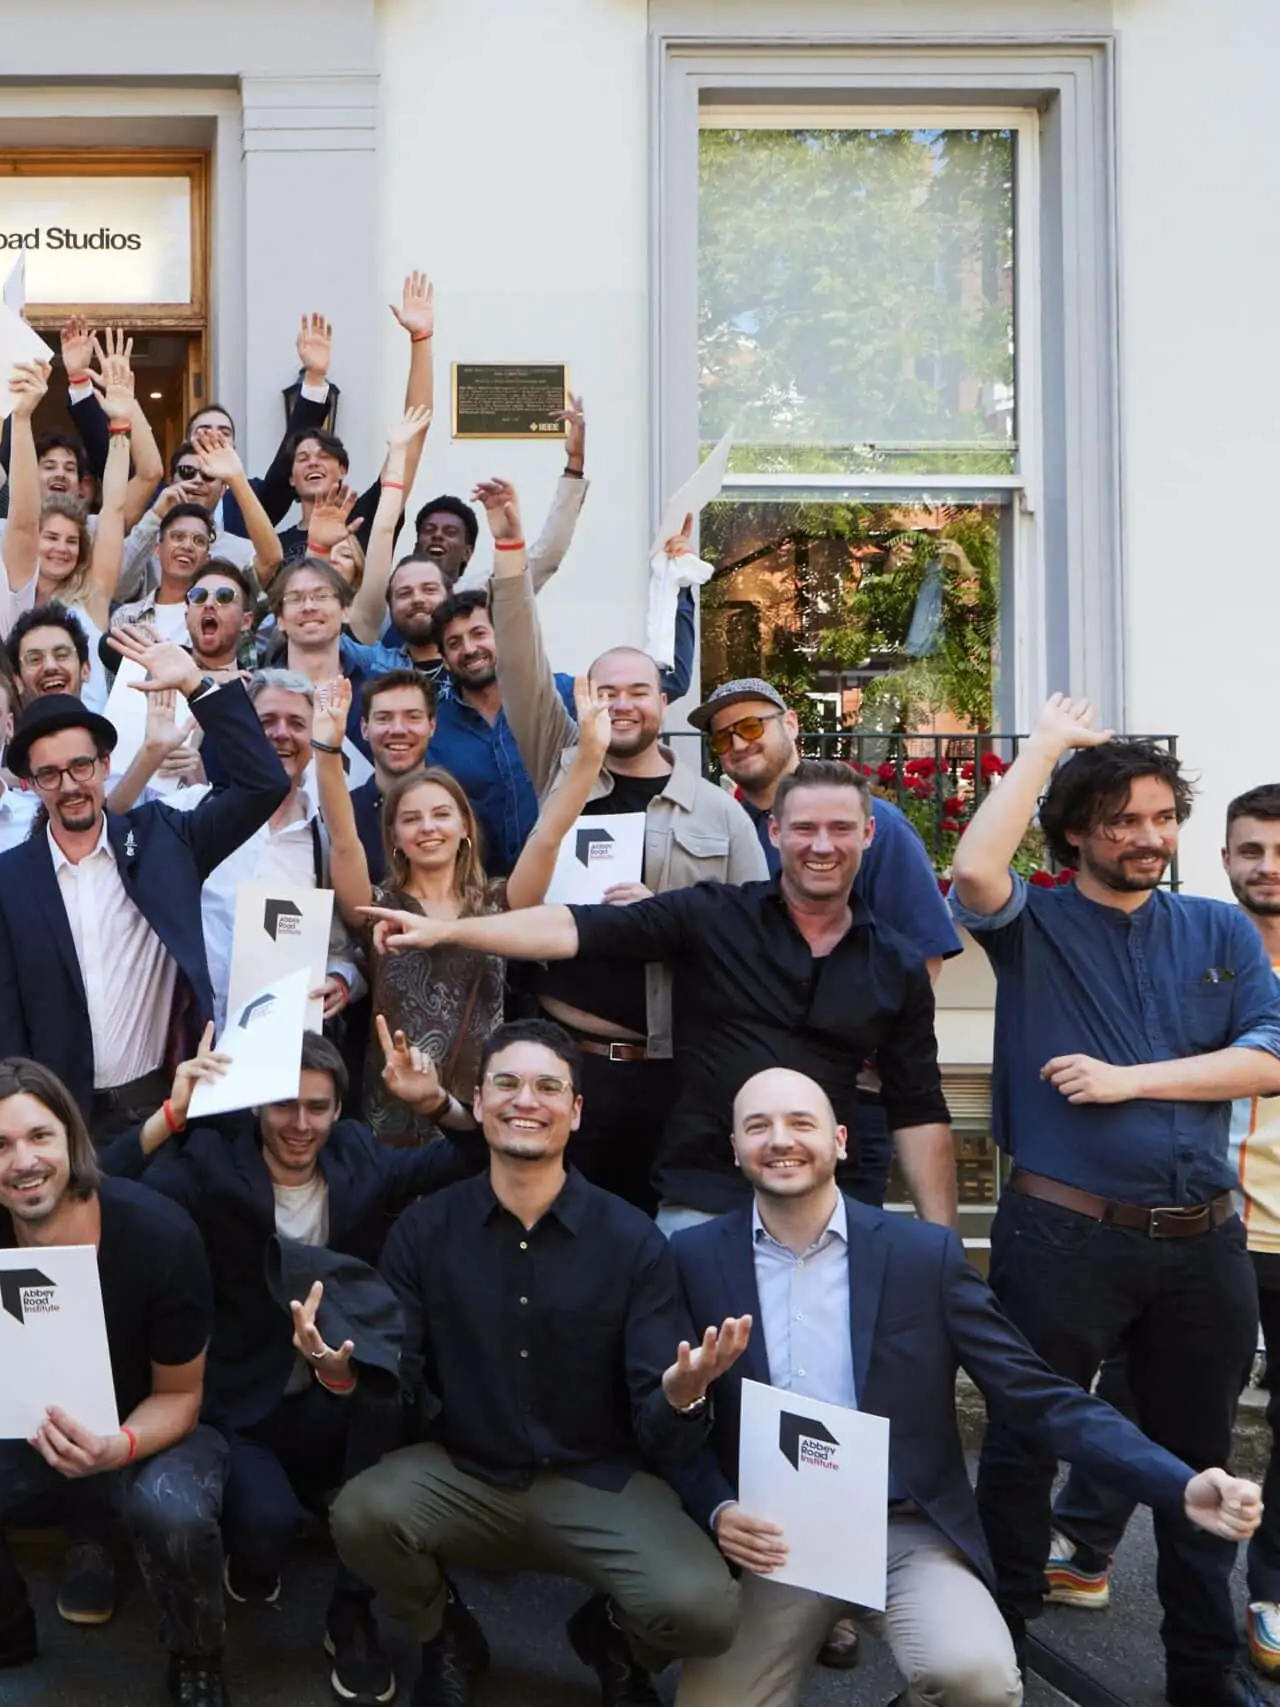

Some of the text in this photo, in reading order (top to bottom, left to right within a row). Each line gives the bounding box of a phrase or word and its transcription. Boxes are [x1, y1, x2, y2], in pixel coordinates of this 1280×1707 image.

[46, 227, 142, 250] Studios
[23, 1289, 55, 1299] Abbey
[24, 1297, 49, 1306] Road
[24, 1304, 60, 1313] Institute
[801, 1446, 828, 1460] Road
[802, 1440, 836, 1455] Abbey
[801, 1455, 839, 1471] Institute
